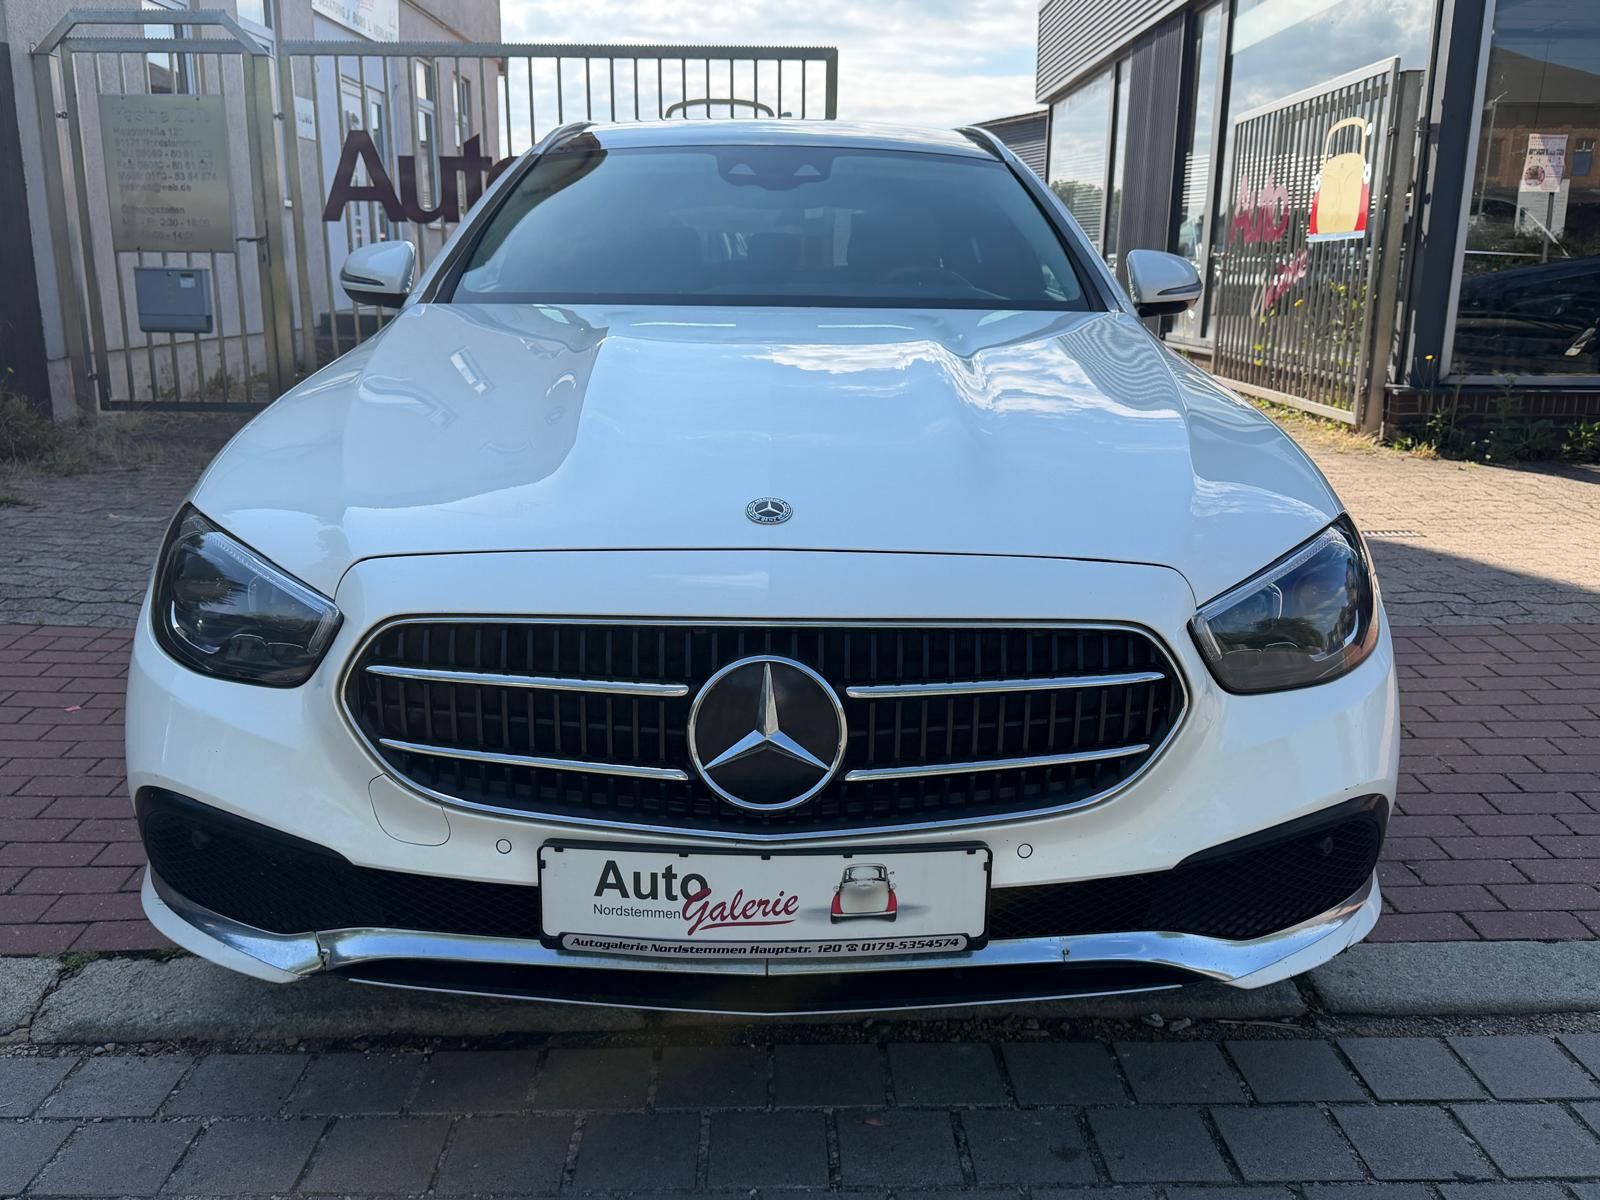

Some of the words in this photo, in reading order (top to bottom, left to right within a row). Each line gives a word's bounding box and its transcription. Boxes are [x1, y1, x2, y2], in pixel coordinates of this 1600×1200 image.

[594, 860, 709, 902] Auto
[593, 904, 681, 919] Nordstemmen
[682, 887, 799, 936] Galerie
[571, 937, 648, 952] Autogalerie
[650, 943, 747, 954] Nordstemmen
[750, 944, 811, 955] Hauptstr.
[818, 944, 842, 953] 120
[861, 937, 959, 951] 0179-5354574
